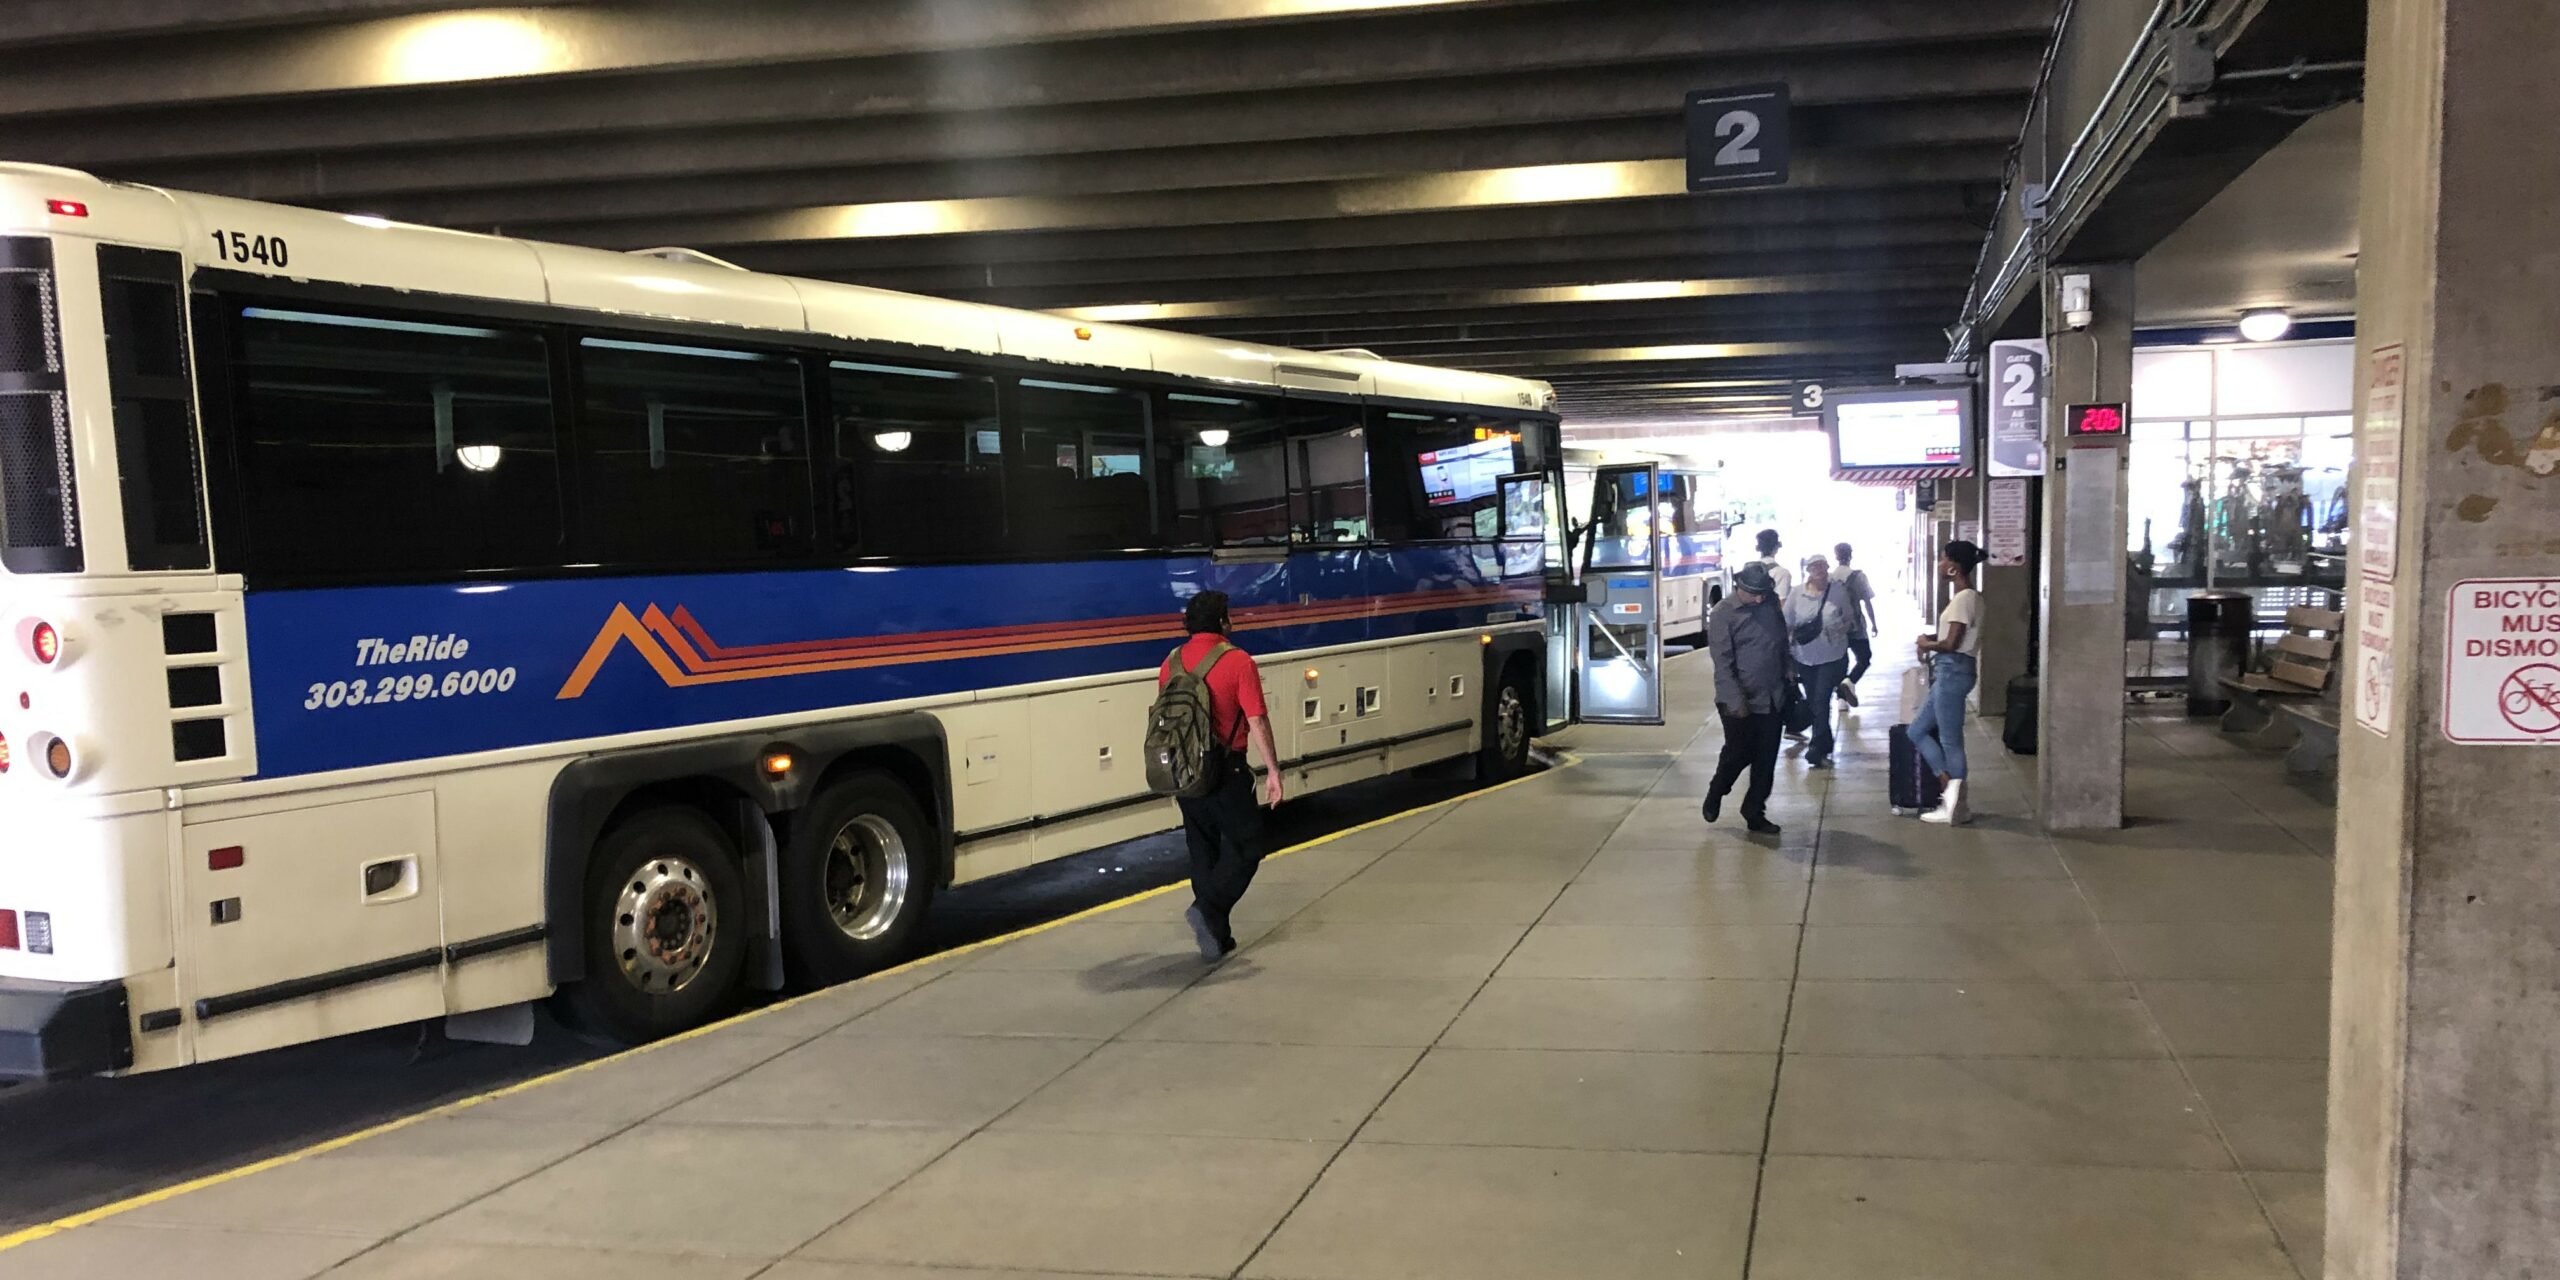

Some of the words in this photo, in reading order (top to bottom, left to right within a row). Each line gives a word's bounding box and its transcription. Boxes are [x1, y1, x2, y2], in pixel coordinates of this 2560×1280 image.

[1714, 109, 1761, 167] 2
[211, 229, 288, 268] 1540
[1802, 384, 1824, 408] 3
[2002, 363, 2035, 407] 2
[2474, 590, 2560, 609] BICYC
[2502, 614, 2560, 633] MUS
[355, 633, 469, 666] TheRide
[2466, 638, 2560, 657] DISMO
[304, 667, 516, 711] 303.299.6000
